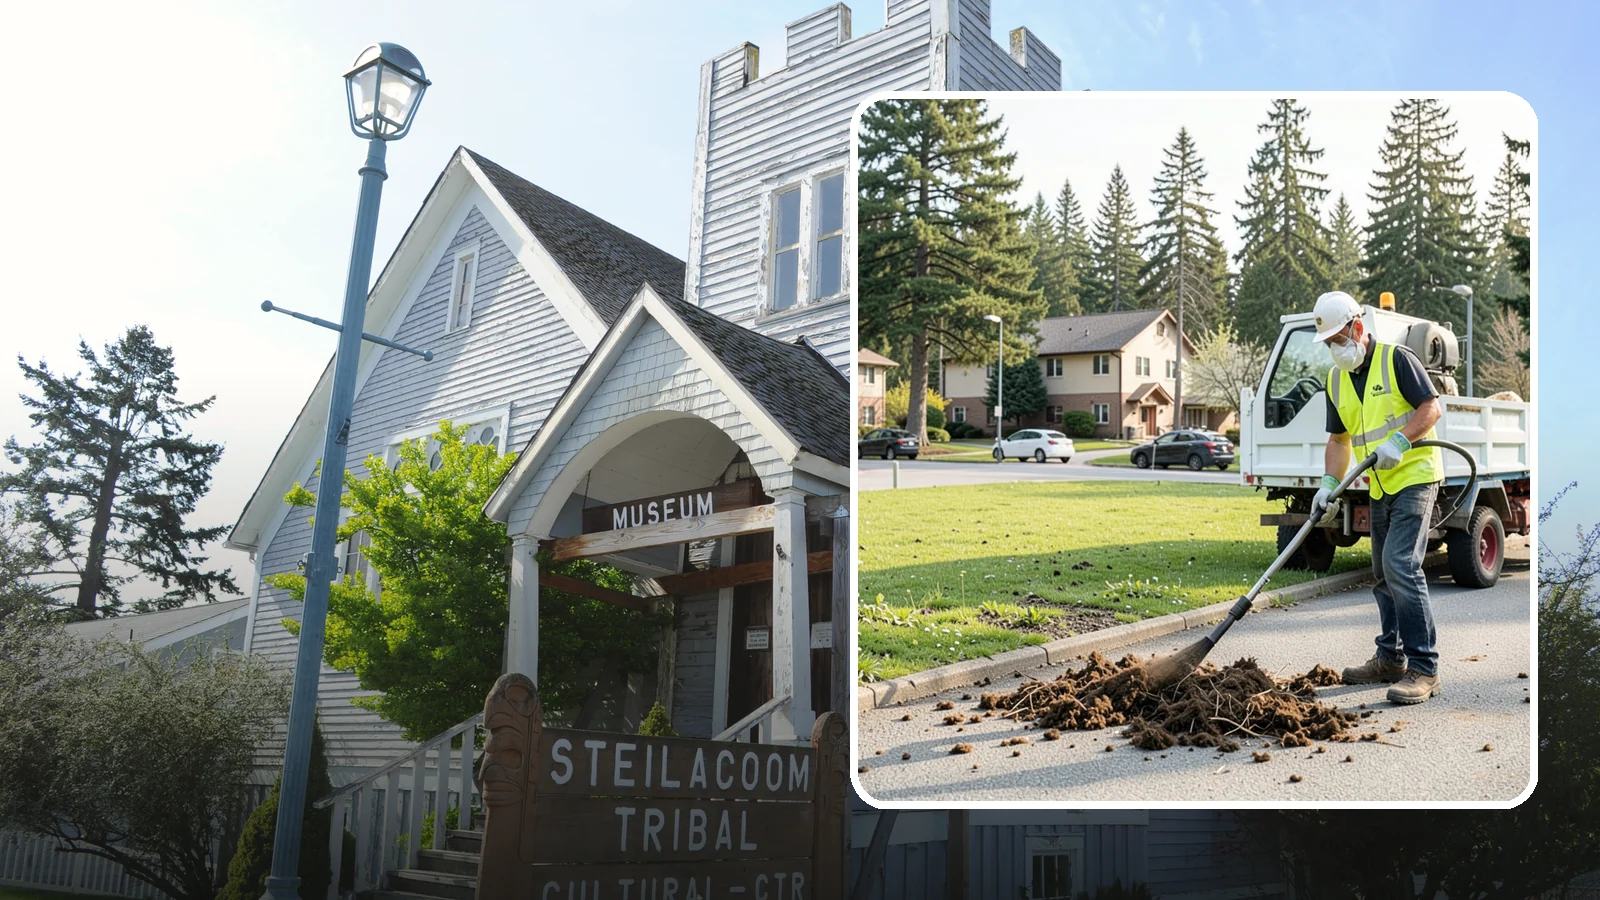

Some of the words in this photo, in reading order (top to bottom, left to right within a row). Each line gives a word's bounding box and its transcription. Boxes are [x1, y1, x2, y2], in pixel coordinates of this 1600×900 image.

[613, 491, 714, 530] MUSEUM
[550, 738, 810, 792] STEILACOOM
[614, 806, 758, 851] TRIBAL
